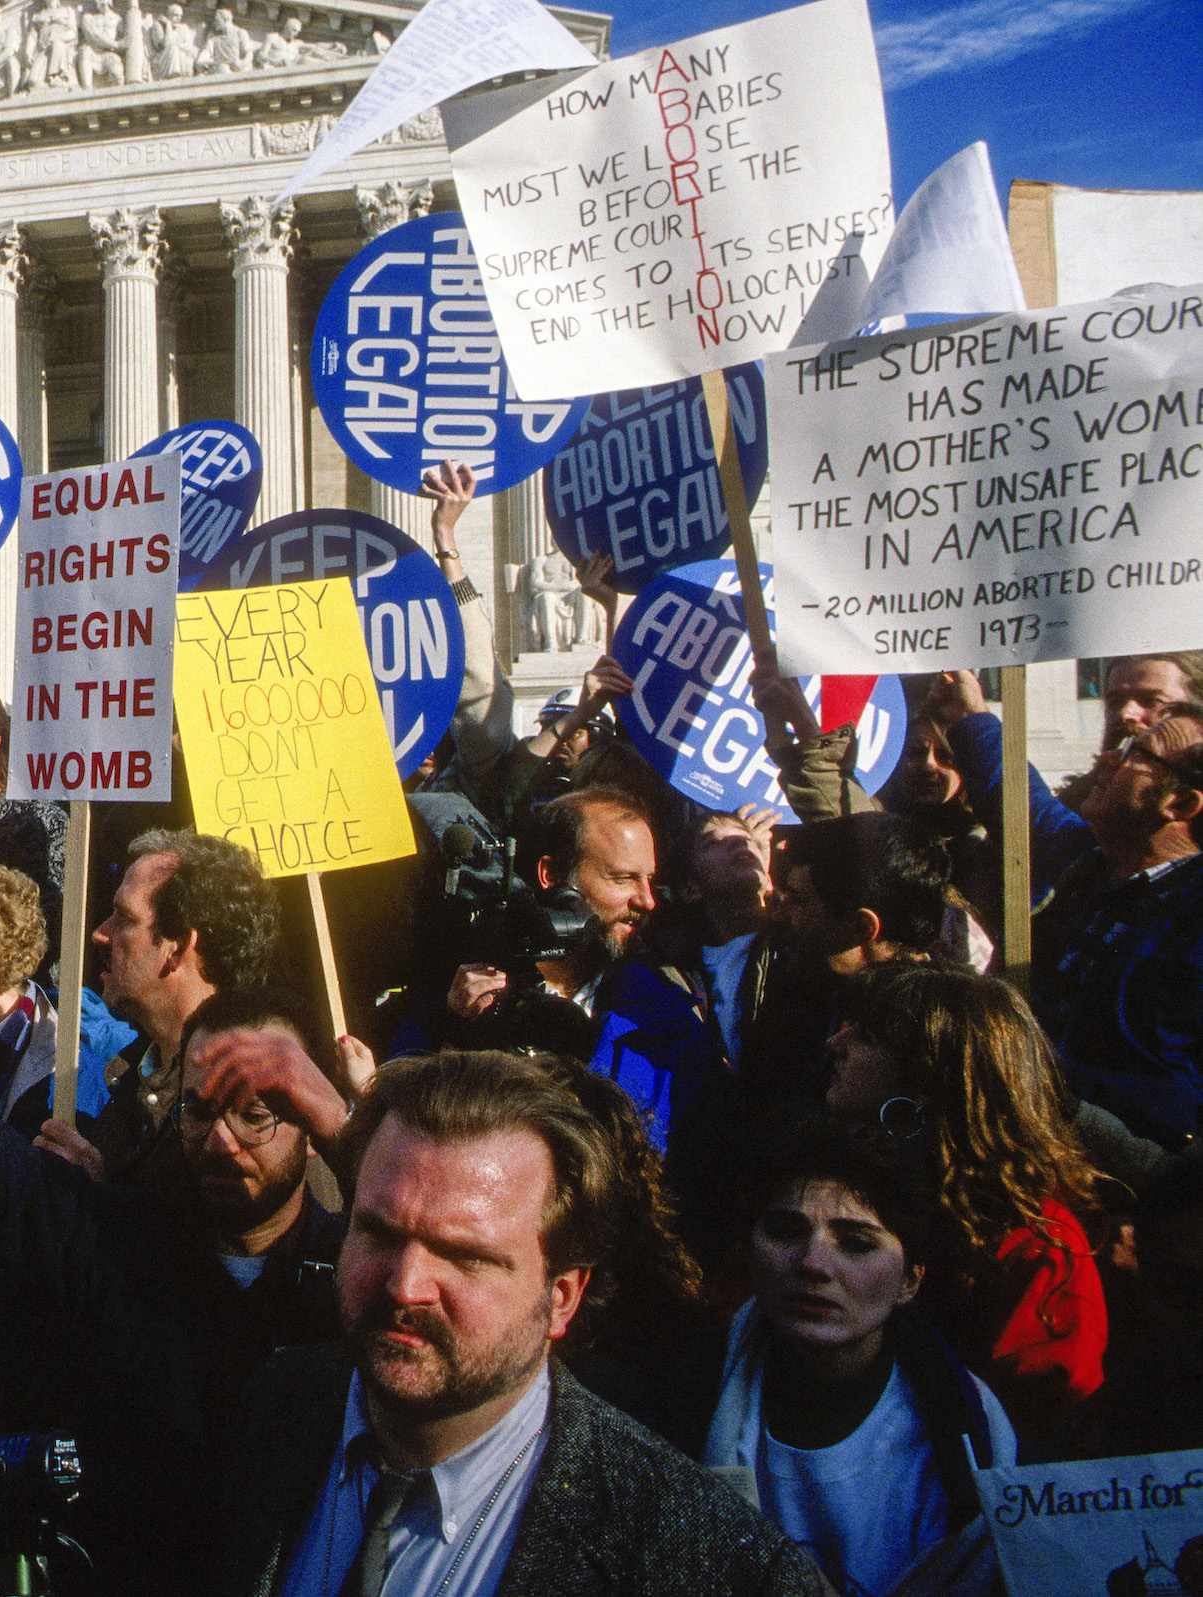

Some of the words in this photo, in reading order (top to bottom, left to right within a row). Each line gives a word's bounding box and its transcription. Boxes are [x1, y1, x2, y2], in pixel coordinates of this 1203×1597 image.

[547, 82, 614, 120] HOW
[629, 45, 730, 98] MANY
[85, 141, 178, 171] UNDER
[185, 135, 240, 158] LAW
[483, 166, 568, 213] MUST
[579, 151, 627, 189] WE
[580, 162, 727, 227] BEFORE
[740, 145, 802, 184] THE
[485, 234, 606, 281] SUPREME
[515, 275, 606, 311] COMES
[625, 259, 673, 289] TO
[767, 193, 892, 254] SENSES?
[531, 317, 580, 345] END
[592, 302, 655, 333] THE
[667, 254, 861, 321] HOLOCAUST
[344, 252, 426, 459] LEGAL
[420, 228, 501, 482] ABORTION
[786, 350, 858, 395] THE
[880, 316, 1068, 383] SUPREME
[1081, 296, 1203, 344] COUR
[907, 380, 985, 422] HAS
[1001, 357, 1109, 409] MADE
[812, 452, 836, 484] A
[857, 416, 1050, 478] MOTHER'S
[32, 465, 166, 520] EQUAL
[788, 496, 852, 530] THE
[864, 480, 968, 525] MOST
[976, 459, 1101, 506] UNSAFE
[1120, 443, 1203, 488] PLAC
[24, 534, 170, 588] RIGHTS
[864, 528, 910, 569] IN
[931, 502, 1140, 564] AMERICA
[176, 583, 329, 642] EVERY
[867, 586, 964, 616] MILLION
[973, 567, 1095, 607] ABORTED
[32, 607, 153, 654] BEGIN
[196, 631, 314, 684] YEAR
[874, 626, 952, 655] SINCE
[26, 684, 60, 721] IN
[75, 678, 155, 719] THE
[26, 750, 152, 790] WOMB
[215, 774, 291, 825] GET
[323, 768, 351, 814] A
[995, 1477, 1134, 1528] March
